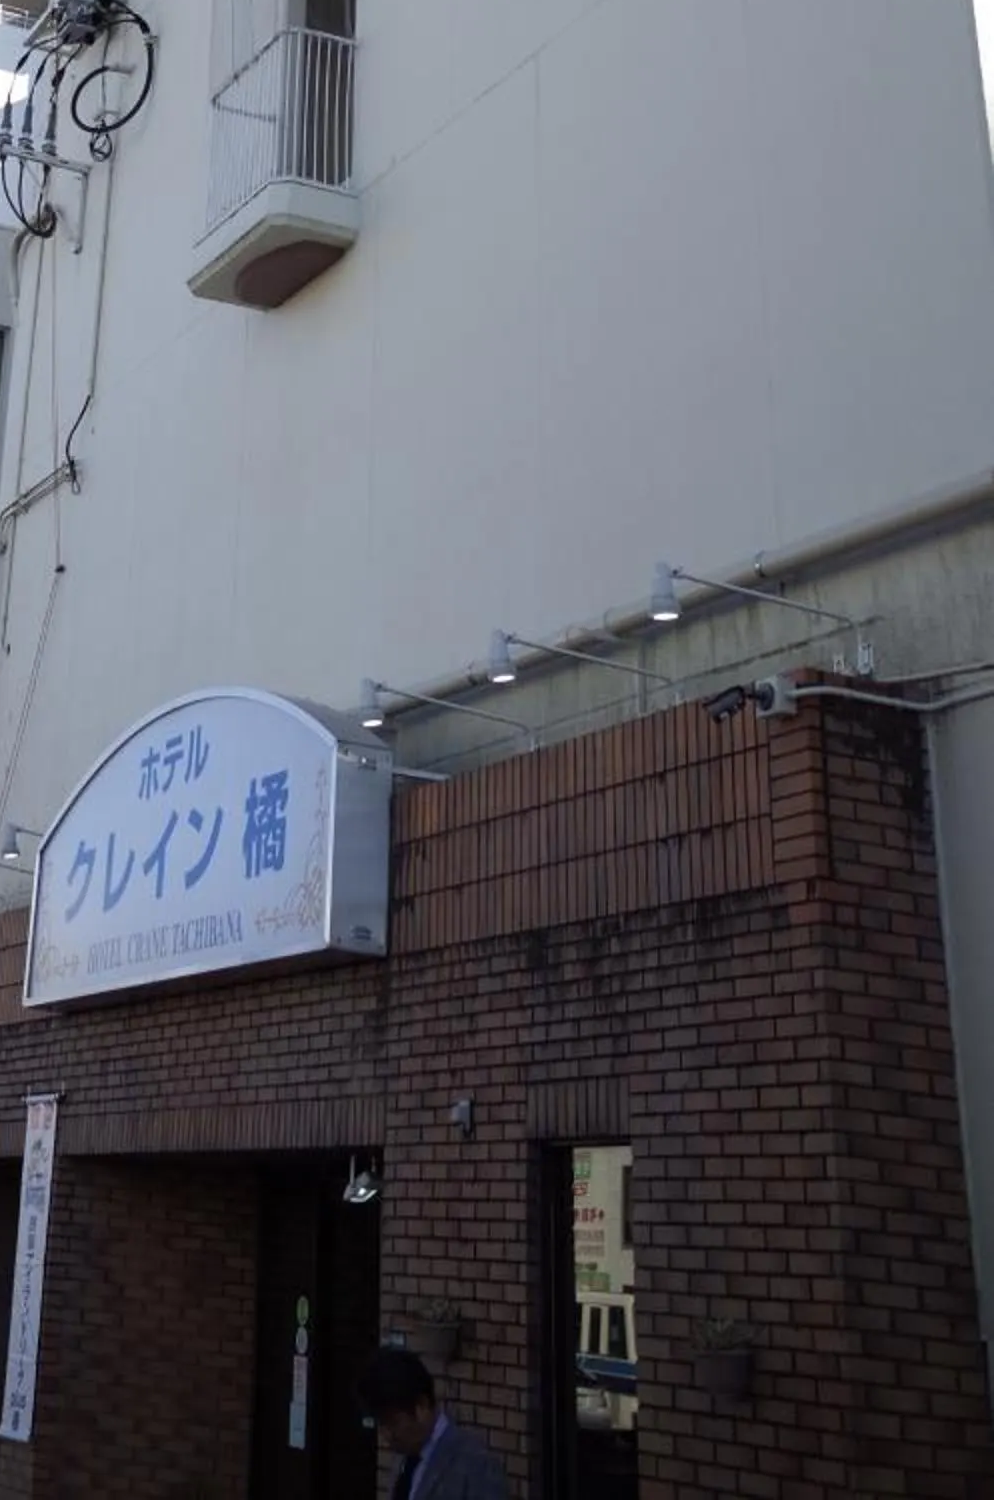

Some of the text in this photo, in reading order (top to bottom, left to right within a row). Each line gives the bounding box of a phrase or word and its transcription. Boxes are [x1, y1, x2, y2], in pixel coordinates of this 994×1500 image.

[138, 723, 210, 800] ホテル
[88, 910, 244, 974] HOTEL CRANE TACHIBANA
